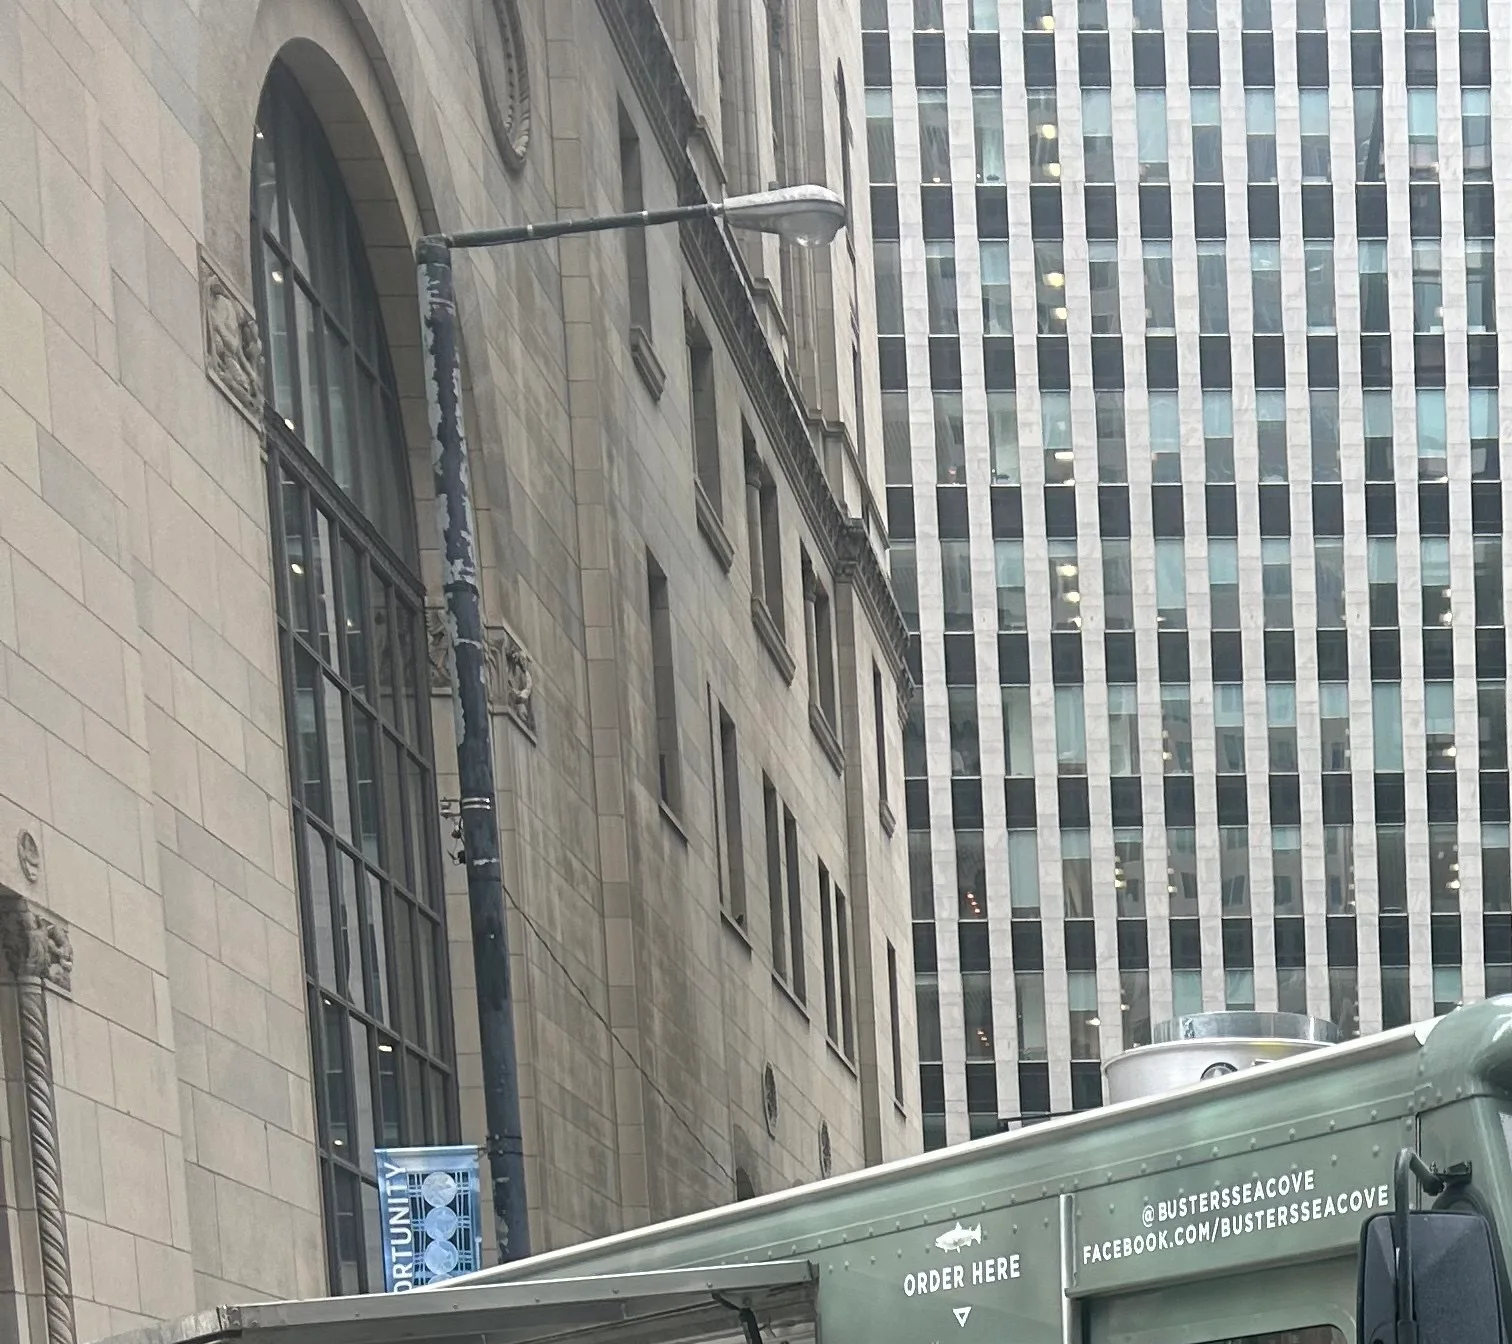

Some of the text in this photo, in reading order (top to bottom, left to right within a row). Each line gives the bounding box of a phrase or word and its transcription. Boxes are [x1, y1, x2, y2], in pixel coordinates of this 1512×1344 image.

[1082, 1184, 1389, 1266] FACEBOOK.COM/BUSTERSSEACOVE
[1141, 1170, 1316, 1229] @BUSTERSSEACOVE
[903, 1254, 1022, 1298] ORDER HERE
